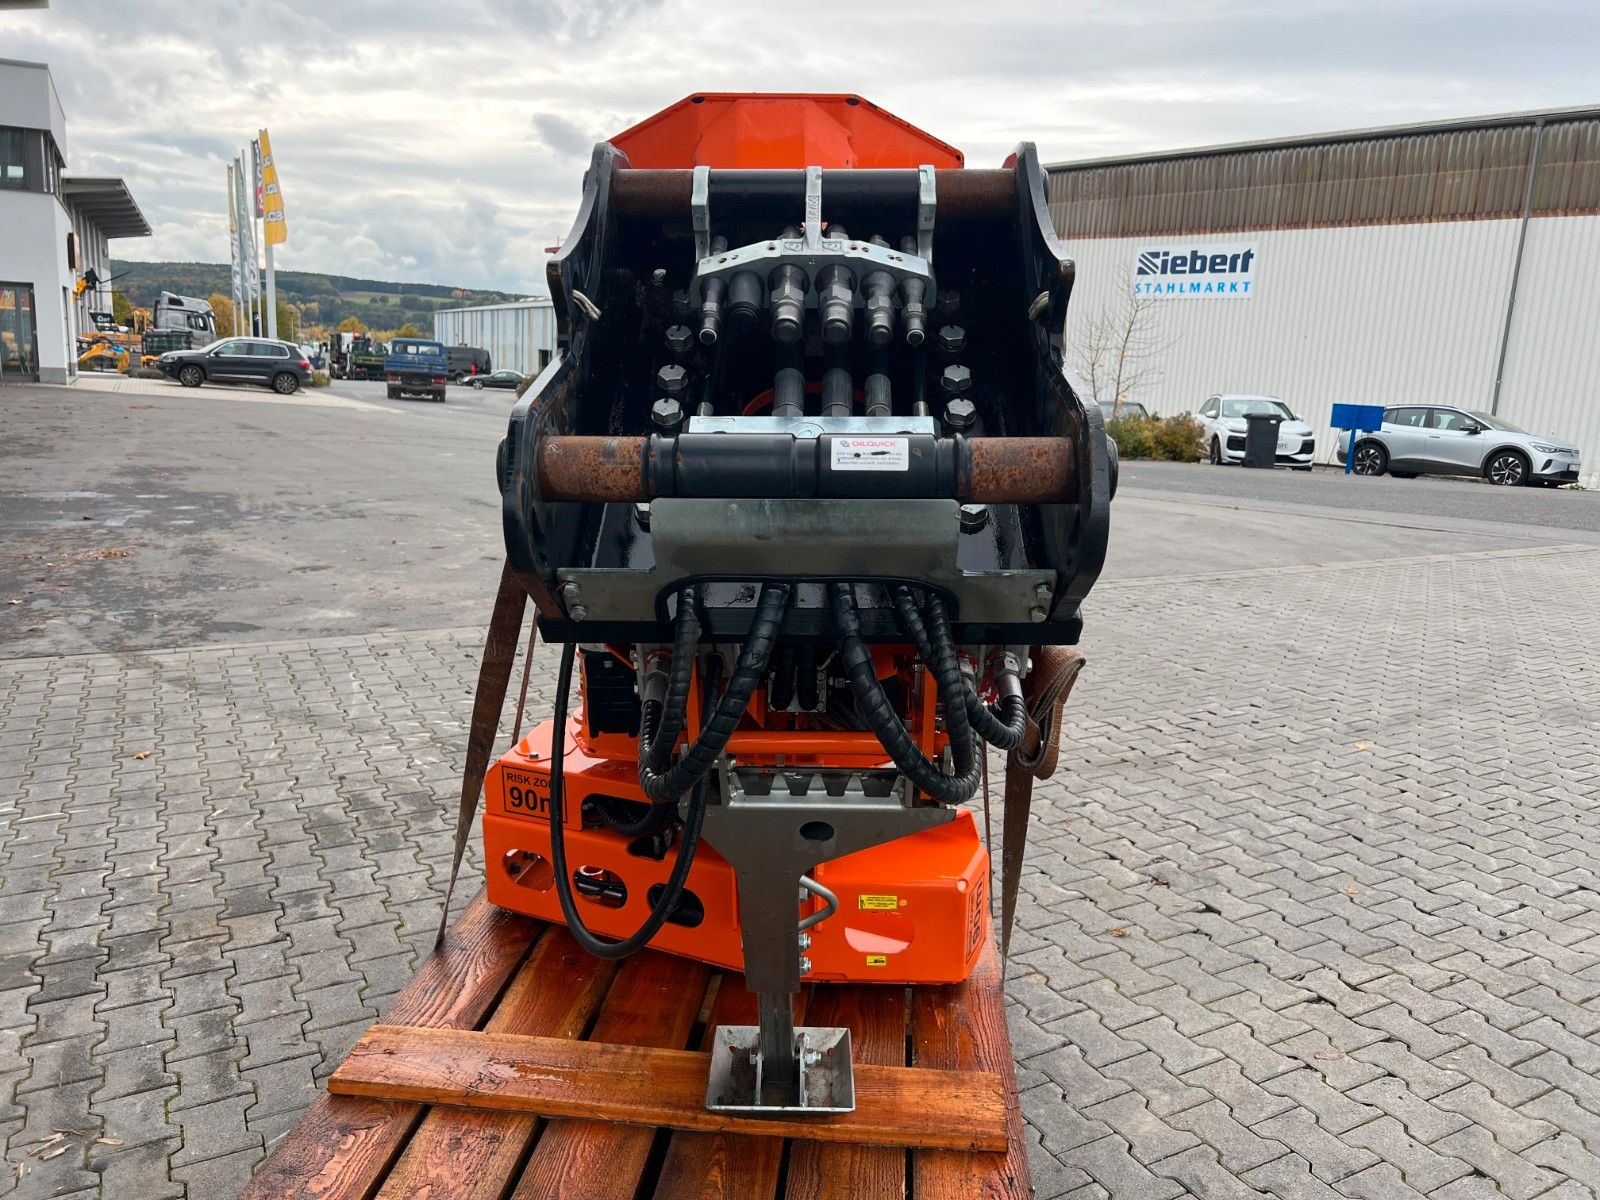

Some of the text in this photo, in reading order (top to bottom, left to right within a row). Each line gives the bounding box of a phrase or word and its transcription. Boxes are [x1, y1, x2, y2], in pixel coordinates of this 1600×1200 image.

[1137, 248, 1254, 275] Siebert
[1135, 281, 1251, 294] STAHLMARKT
[507, 773, 531, 785] RISK
